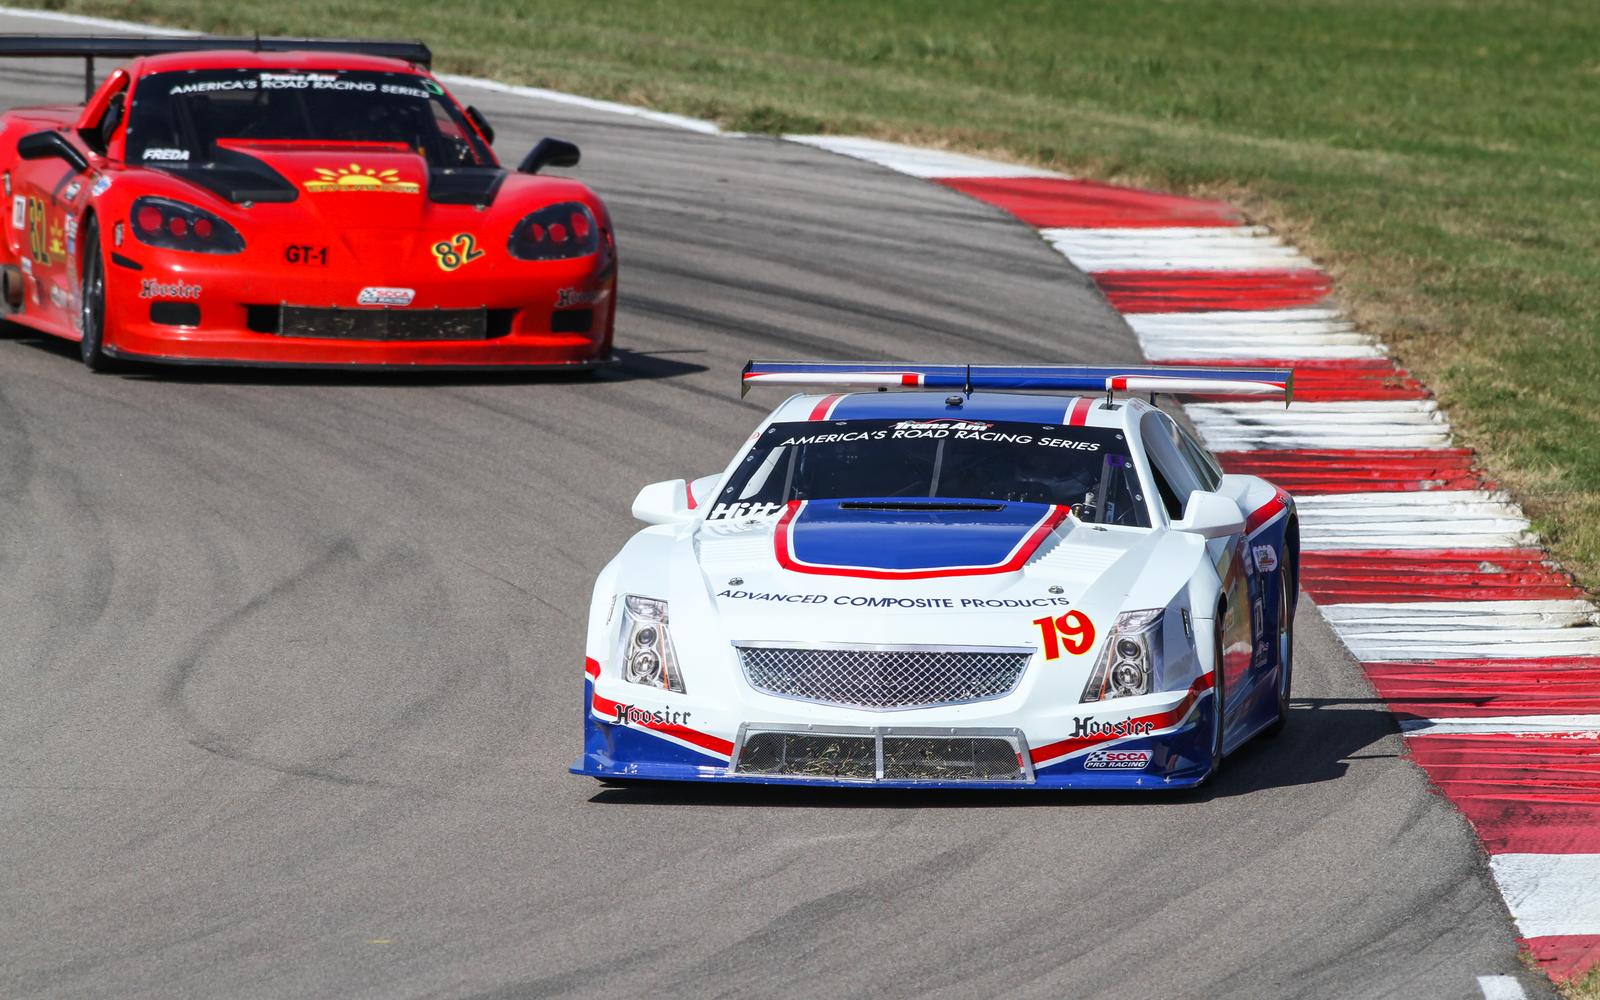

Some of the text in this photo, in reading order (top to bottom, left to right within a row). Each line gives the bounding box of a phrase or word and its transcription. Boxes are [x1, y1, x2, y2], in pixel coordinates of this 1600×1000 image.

[260, 73, 304, 82] Trans
[169, 80, 430, 99] AMERICA'S ROAD RACING SERIES
[142, 148, 190, 161] FREDA
[285, 244, 328, 266] GT-1
[431, 232, 485, 272] 82
[894, 421, 988, 431] Trans Am
[780, 429, 1101, 451] AMERICA'S ROAD RACING SERIES
[709, 502, 782, 520] Hitt
[716, 590, 1071, 609] ADVANCED COMPOSITE PRODUCTS
[1032, 609, 1097, 662] 19
[611, 704, 692, 725] Hoosier
[1069, 715, 1155, 738] Hoosier
[1106, 752, 1148, 761] SCCA
